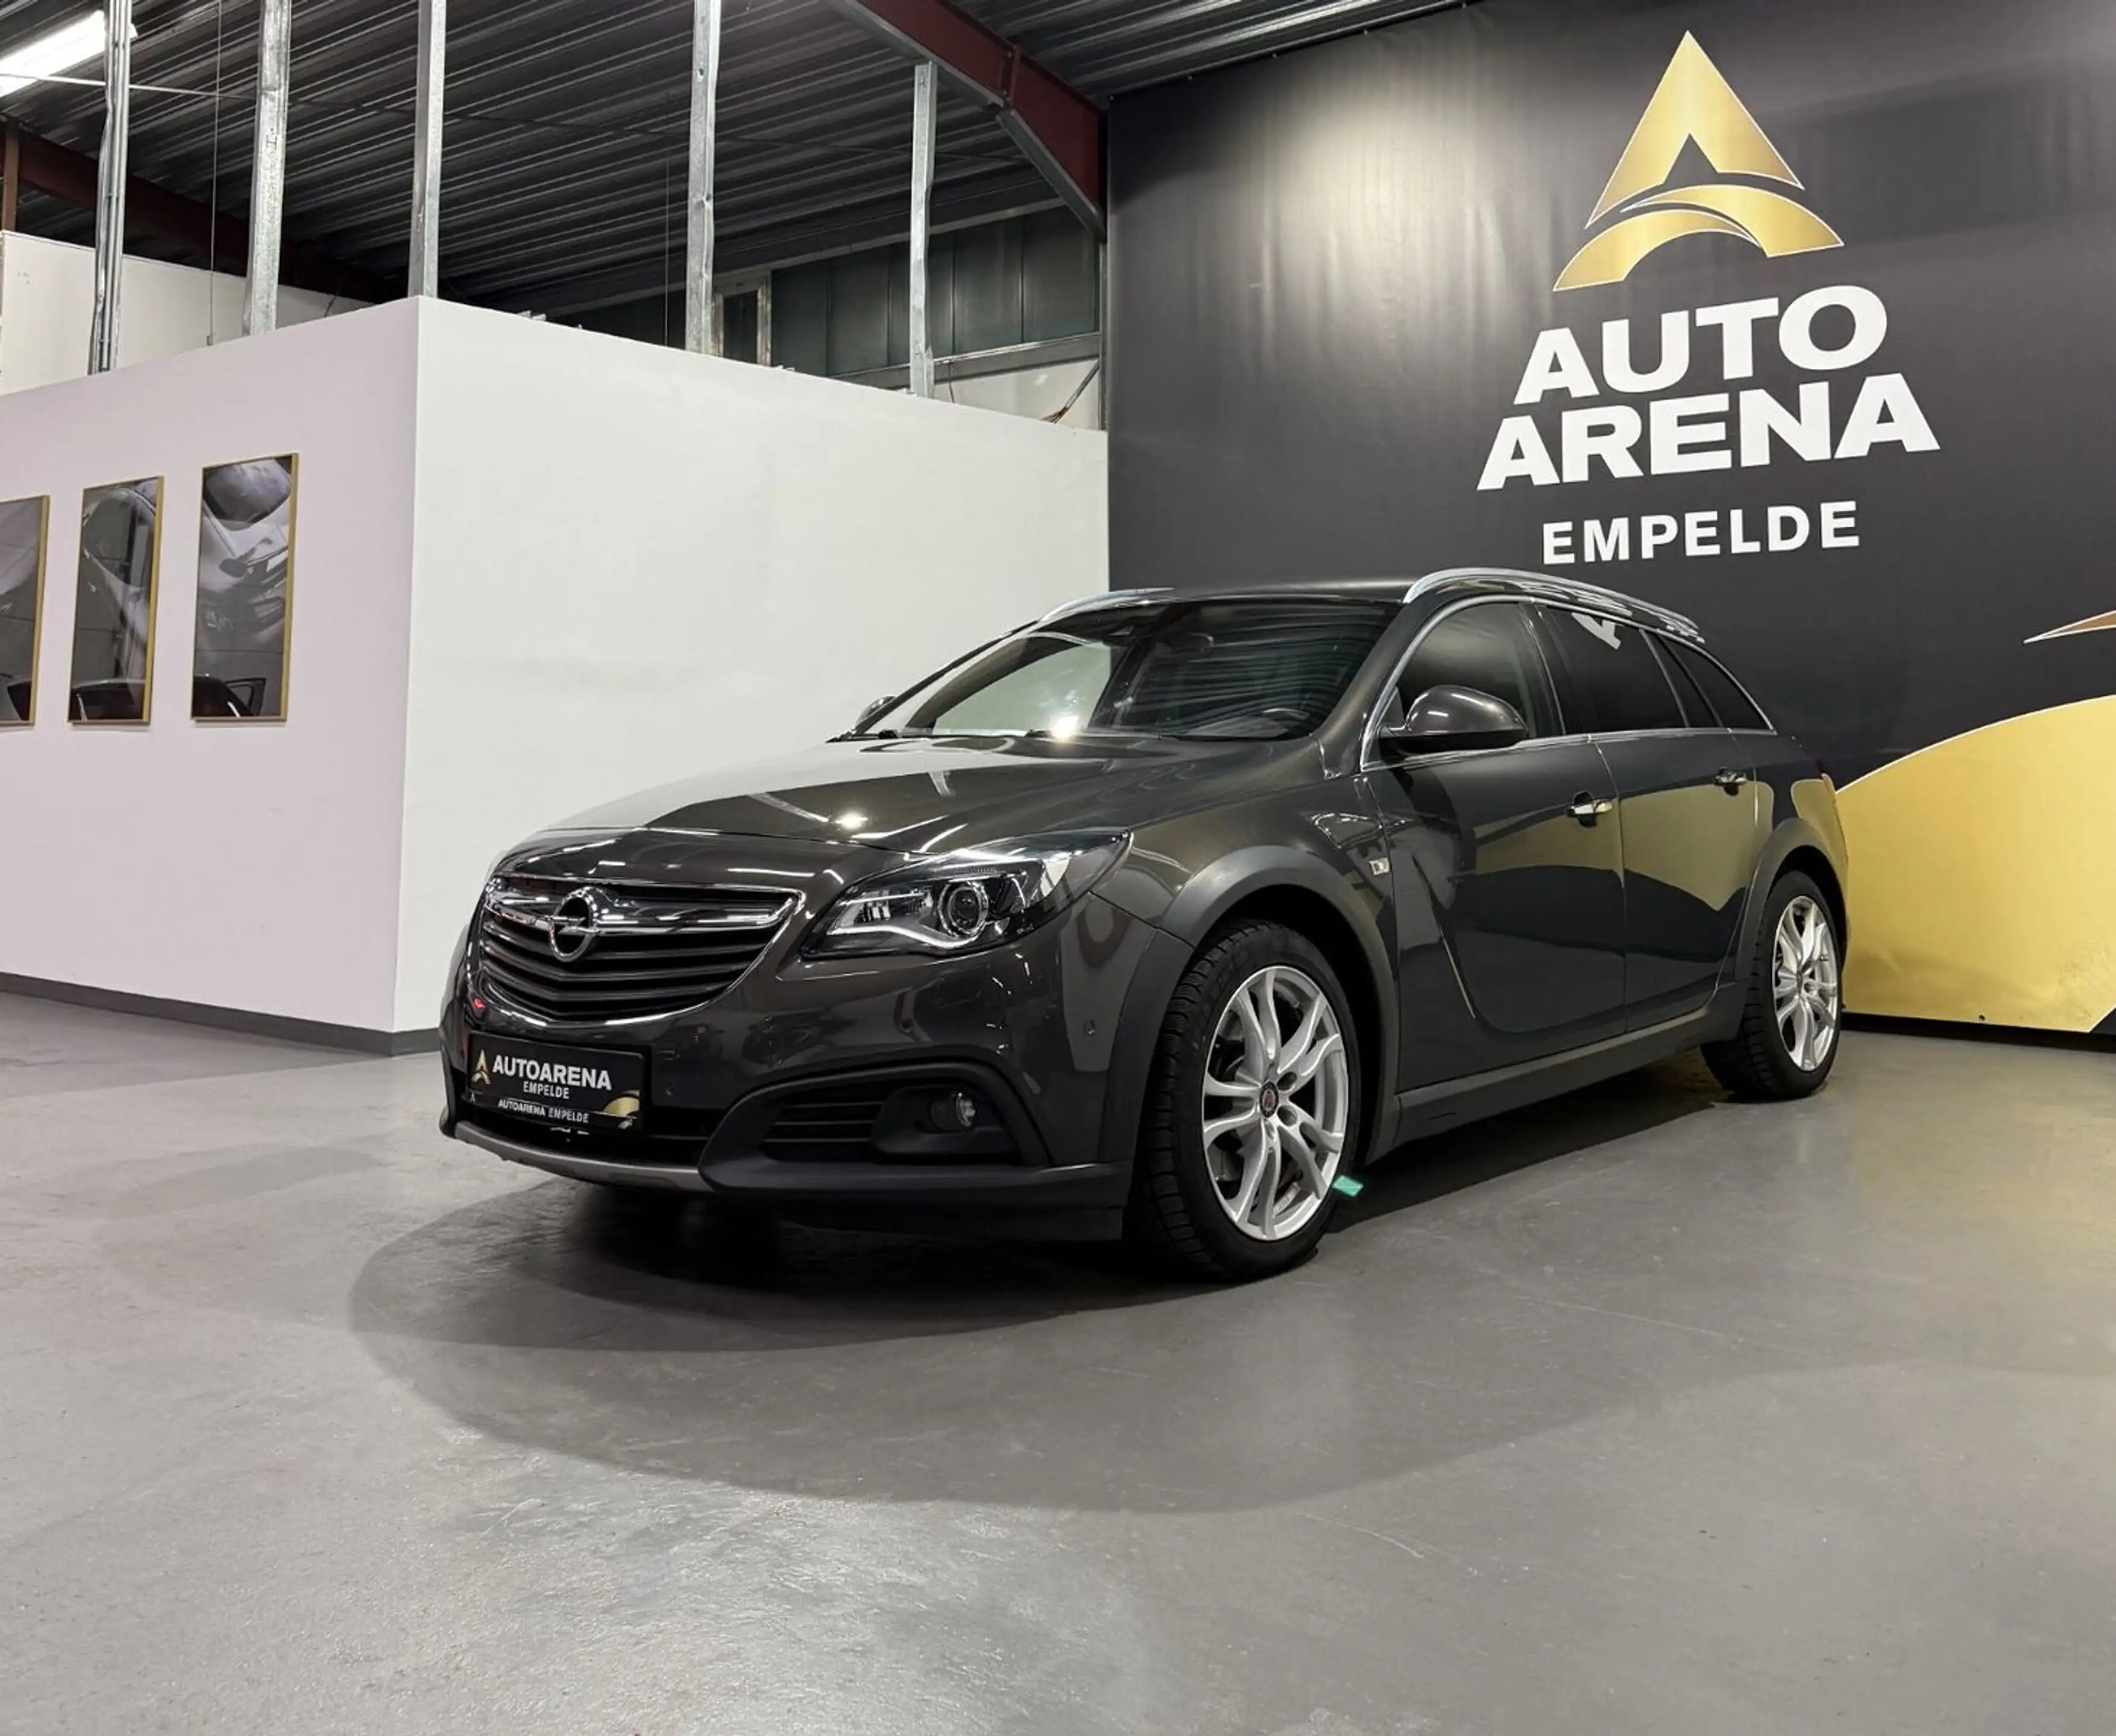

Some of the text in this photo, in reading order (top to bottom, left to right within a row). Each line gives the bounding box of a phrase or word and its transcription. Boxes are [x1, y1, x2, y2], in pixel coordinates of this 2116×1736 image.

[1513, 285, 1888, 405] AUTO
[1477, 373, 1941, 491] ARENA
[1543, 500, 1859, 565] EMPELDE
[492, 1054, 612, 1090] AUTOARENA
[523, 1081, 570, 1099] EMPELDE
[498, 1099, 589, 1124] AUTOARENA EMPELDE
